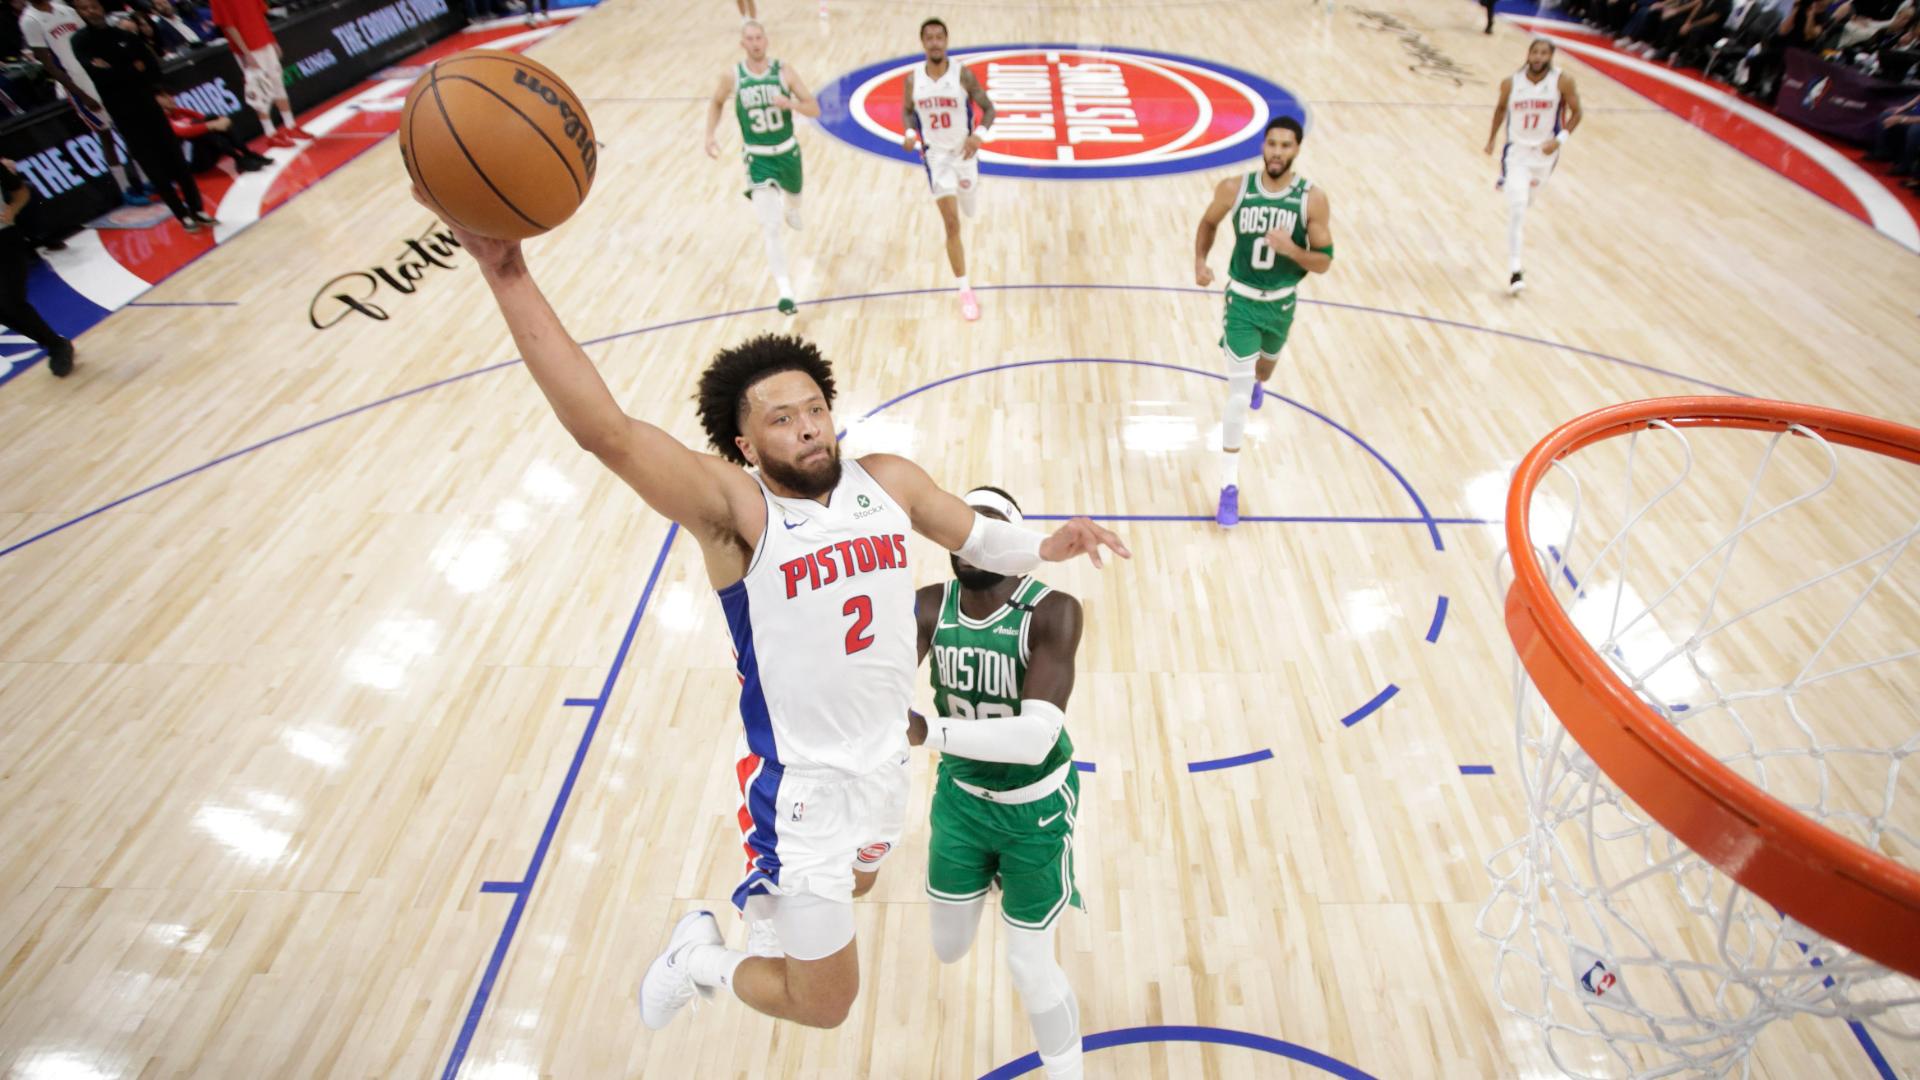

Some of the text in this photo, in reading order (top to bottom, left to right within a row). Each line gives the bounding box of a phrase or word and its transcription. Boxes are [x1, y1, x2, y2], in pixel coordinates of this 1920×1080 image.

[331, 21, 370, 57] THE
[747, 106, 784, 133] 30
[930, 112, 951, 129] 20
[983, 62, 1056, 143] DETROIT
[1058, 62, 1145, 144] PISTONS
[1522, 113, 1540, 129] 17
[16, 147, 86, 200] THE
[1239, 206, 1298, 238] BOSTON
[1251, 236, 1277, 270] 0
[778, 533, 908, 600] PISTONS
[842, 594, 875, 656] 2
[934, 645, 1018, 700] BOSTON
